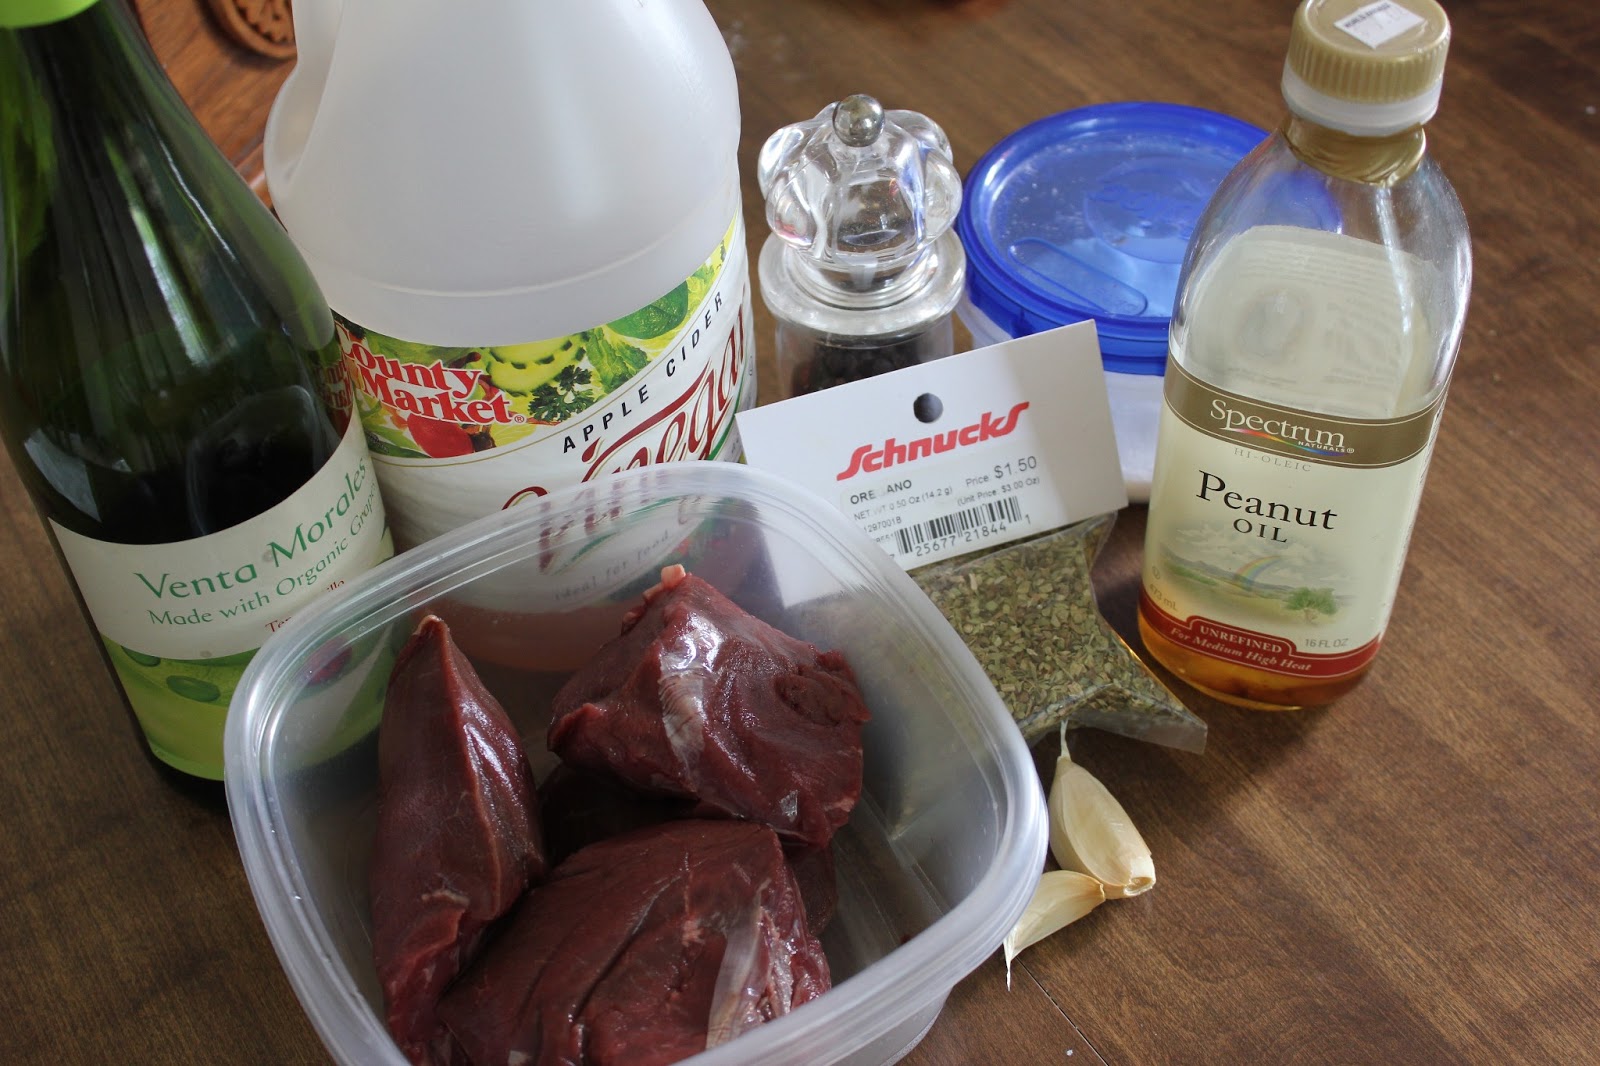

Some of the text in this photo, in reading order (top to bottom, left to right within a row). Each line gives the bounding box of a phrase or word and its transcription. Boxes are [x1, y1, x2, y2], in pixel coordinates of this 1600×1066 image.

[335, 321, 482, 398] County
[563, 384, 649, 453] APPLE
[665, 291, 723, 378] CIDER
[357, 364, 512, 424] Market
[836, 401, 1030, 481] Schnucks
[1210, 399, 1346, 449] Spectrum
[994, 455, 1037, 479] $1.50
[1233, 446, 1312, 473] HI-OLEIC
[1297, 440, 1346, 454] NATURALS
[850, 479, 913, 505] OREANO
[1195, 469, 1338, 530] Peanut
[133, 457, 367, 599] Venta Morales
[915, 535, 957, 557] 25677
[966, 523, 1007, 544] 21844
[1232, 518, 1288, 543] OIL
[147, 609, 213, 625] Made
[219, 591, 270, 618] with
[276, 538, 349, 586] Organic
[1170, 626, 1313, 671] For Medium High Heat
[1200, 625, 1283, 654] UNREFINED
[1305, 638, 1316, 648] 16
[1317, 639, 1331, 649] FL
